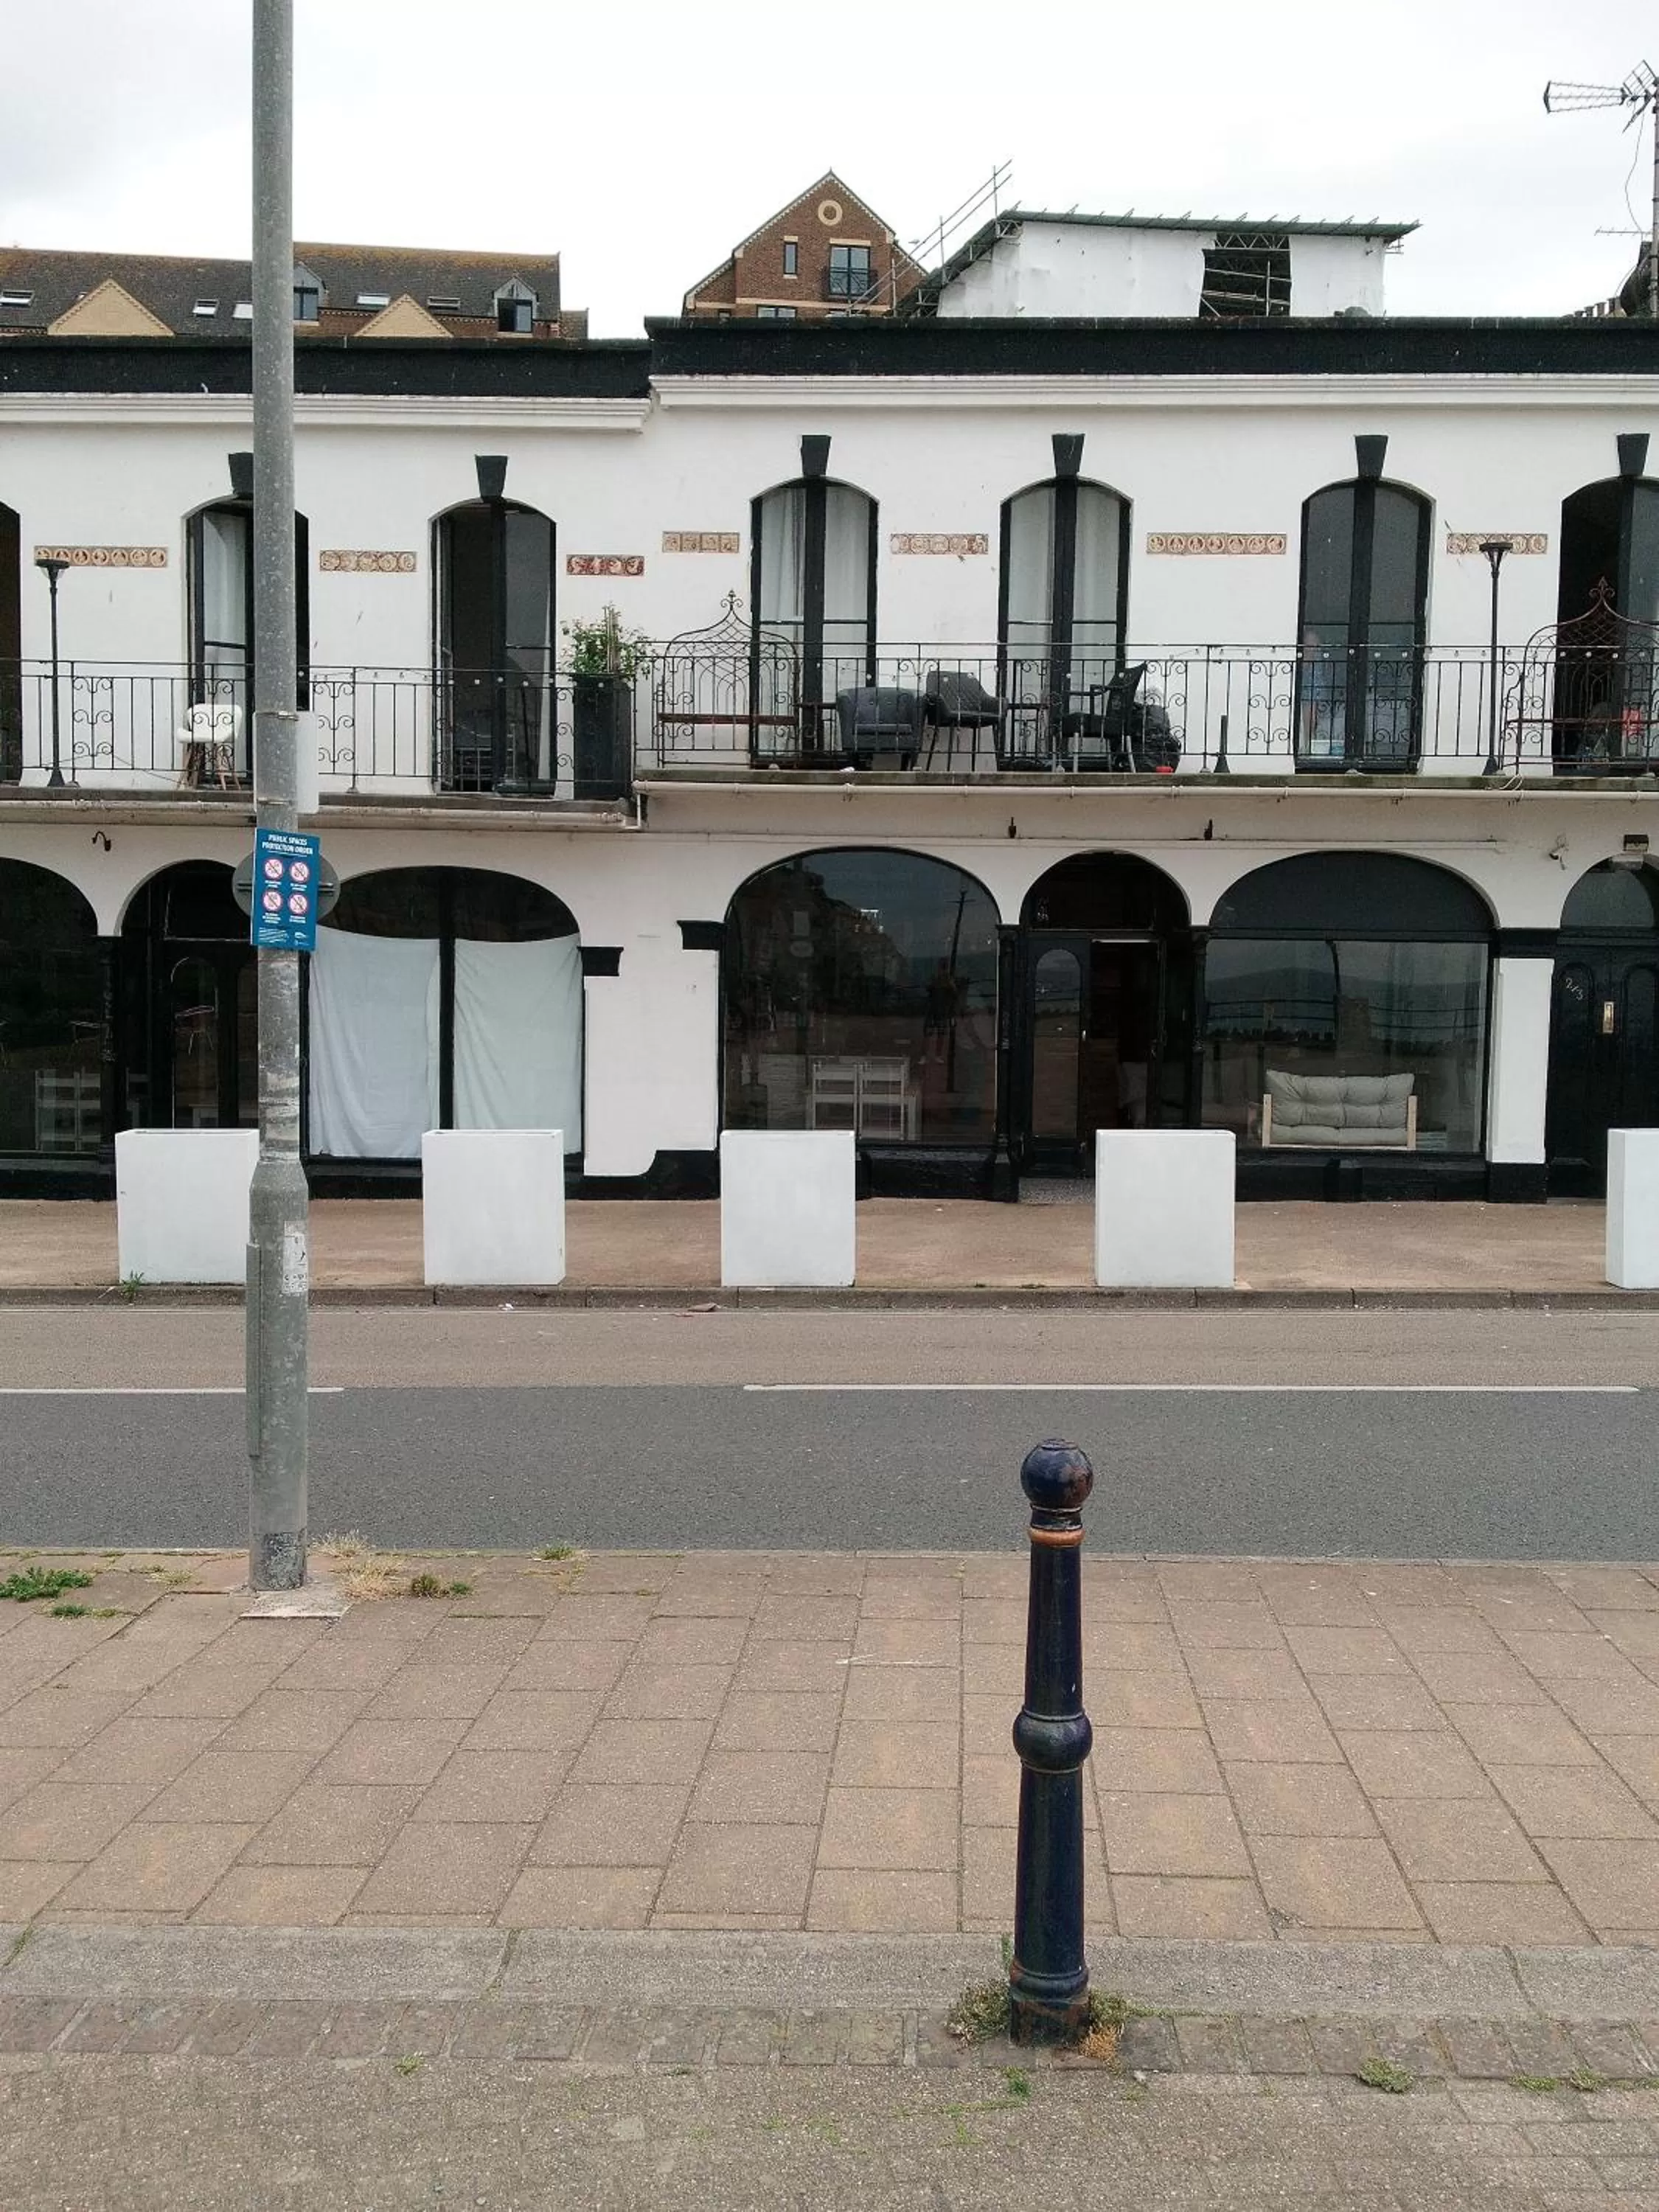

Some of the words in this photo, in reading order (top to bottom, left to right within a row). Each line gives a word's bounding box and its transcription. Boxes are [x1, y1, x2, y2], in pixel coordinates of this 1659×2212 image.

[268, 834, 288, 843] PUBLIC
[288, 837, 307, 846] SPACES
[262, 841, 294, 852] PROTECTION
[294, 846, 313, 855] ORDER
